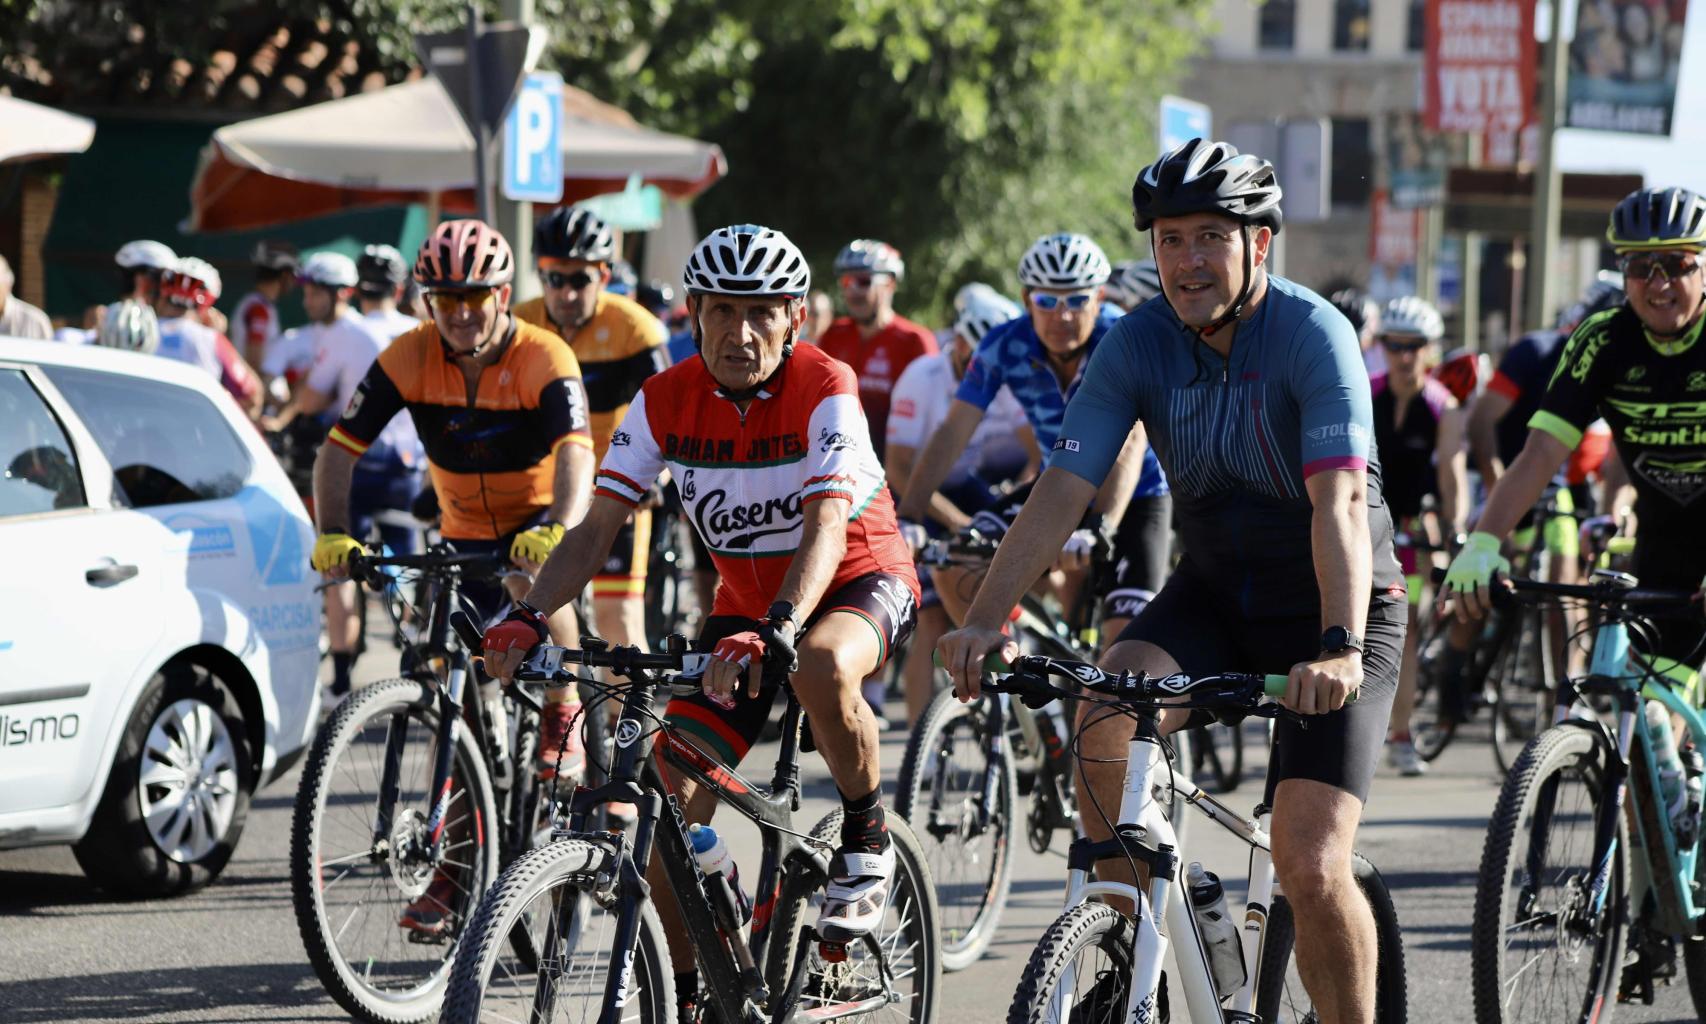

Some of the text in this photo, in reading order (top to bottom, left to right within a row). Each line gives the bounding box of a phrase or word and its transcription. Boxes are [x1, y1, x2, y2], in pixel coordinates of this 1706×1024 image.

[1438, 66, 1522, 110] VOTA
[516, 88, 554, 185] P
[1067, 441, 1078, 450] 19
[681, 469, 697, 501] La
[694, 488, 803, 548] Casera
